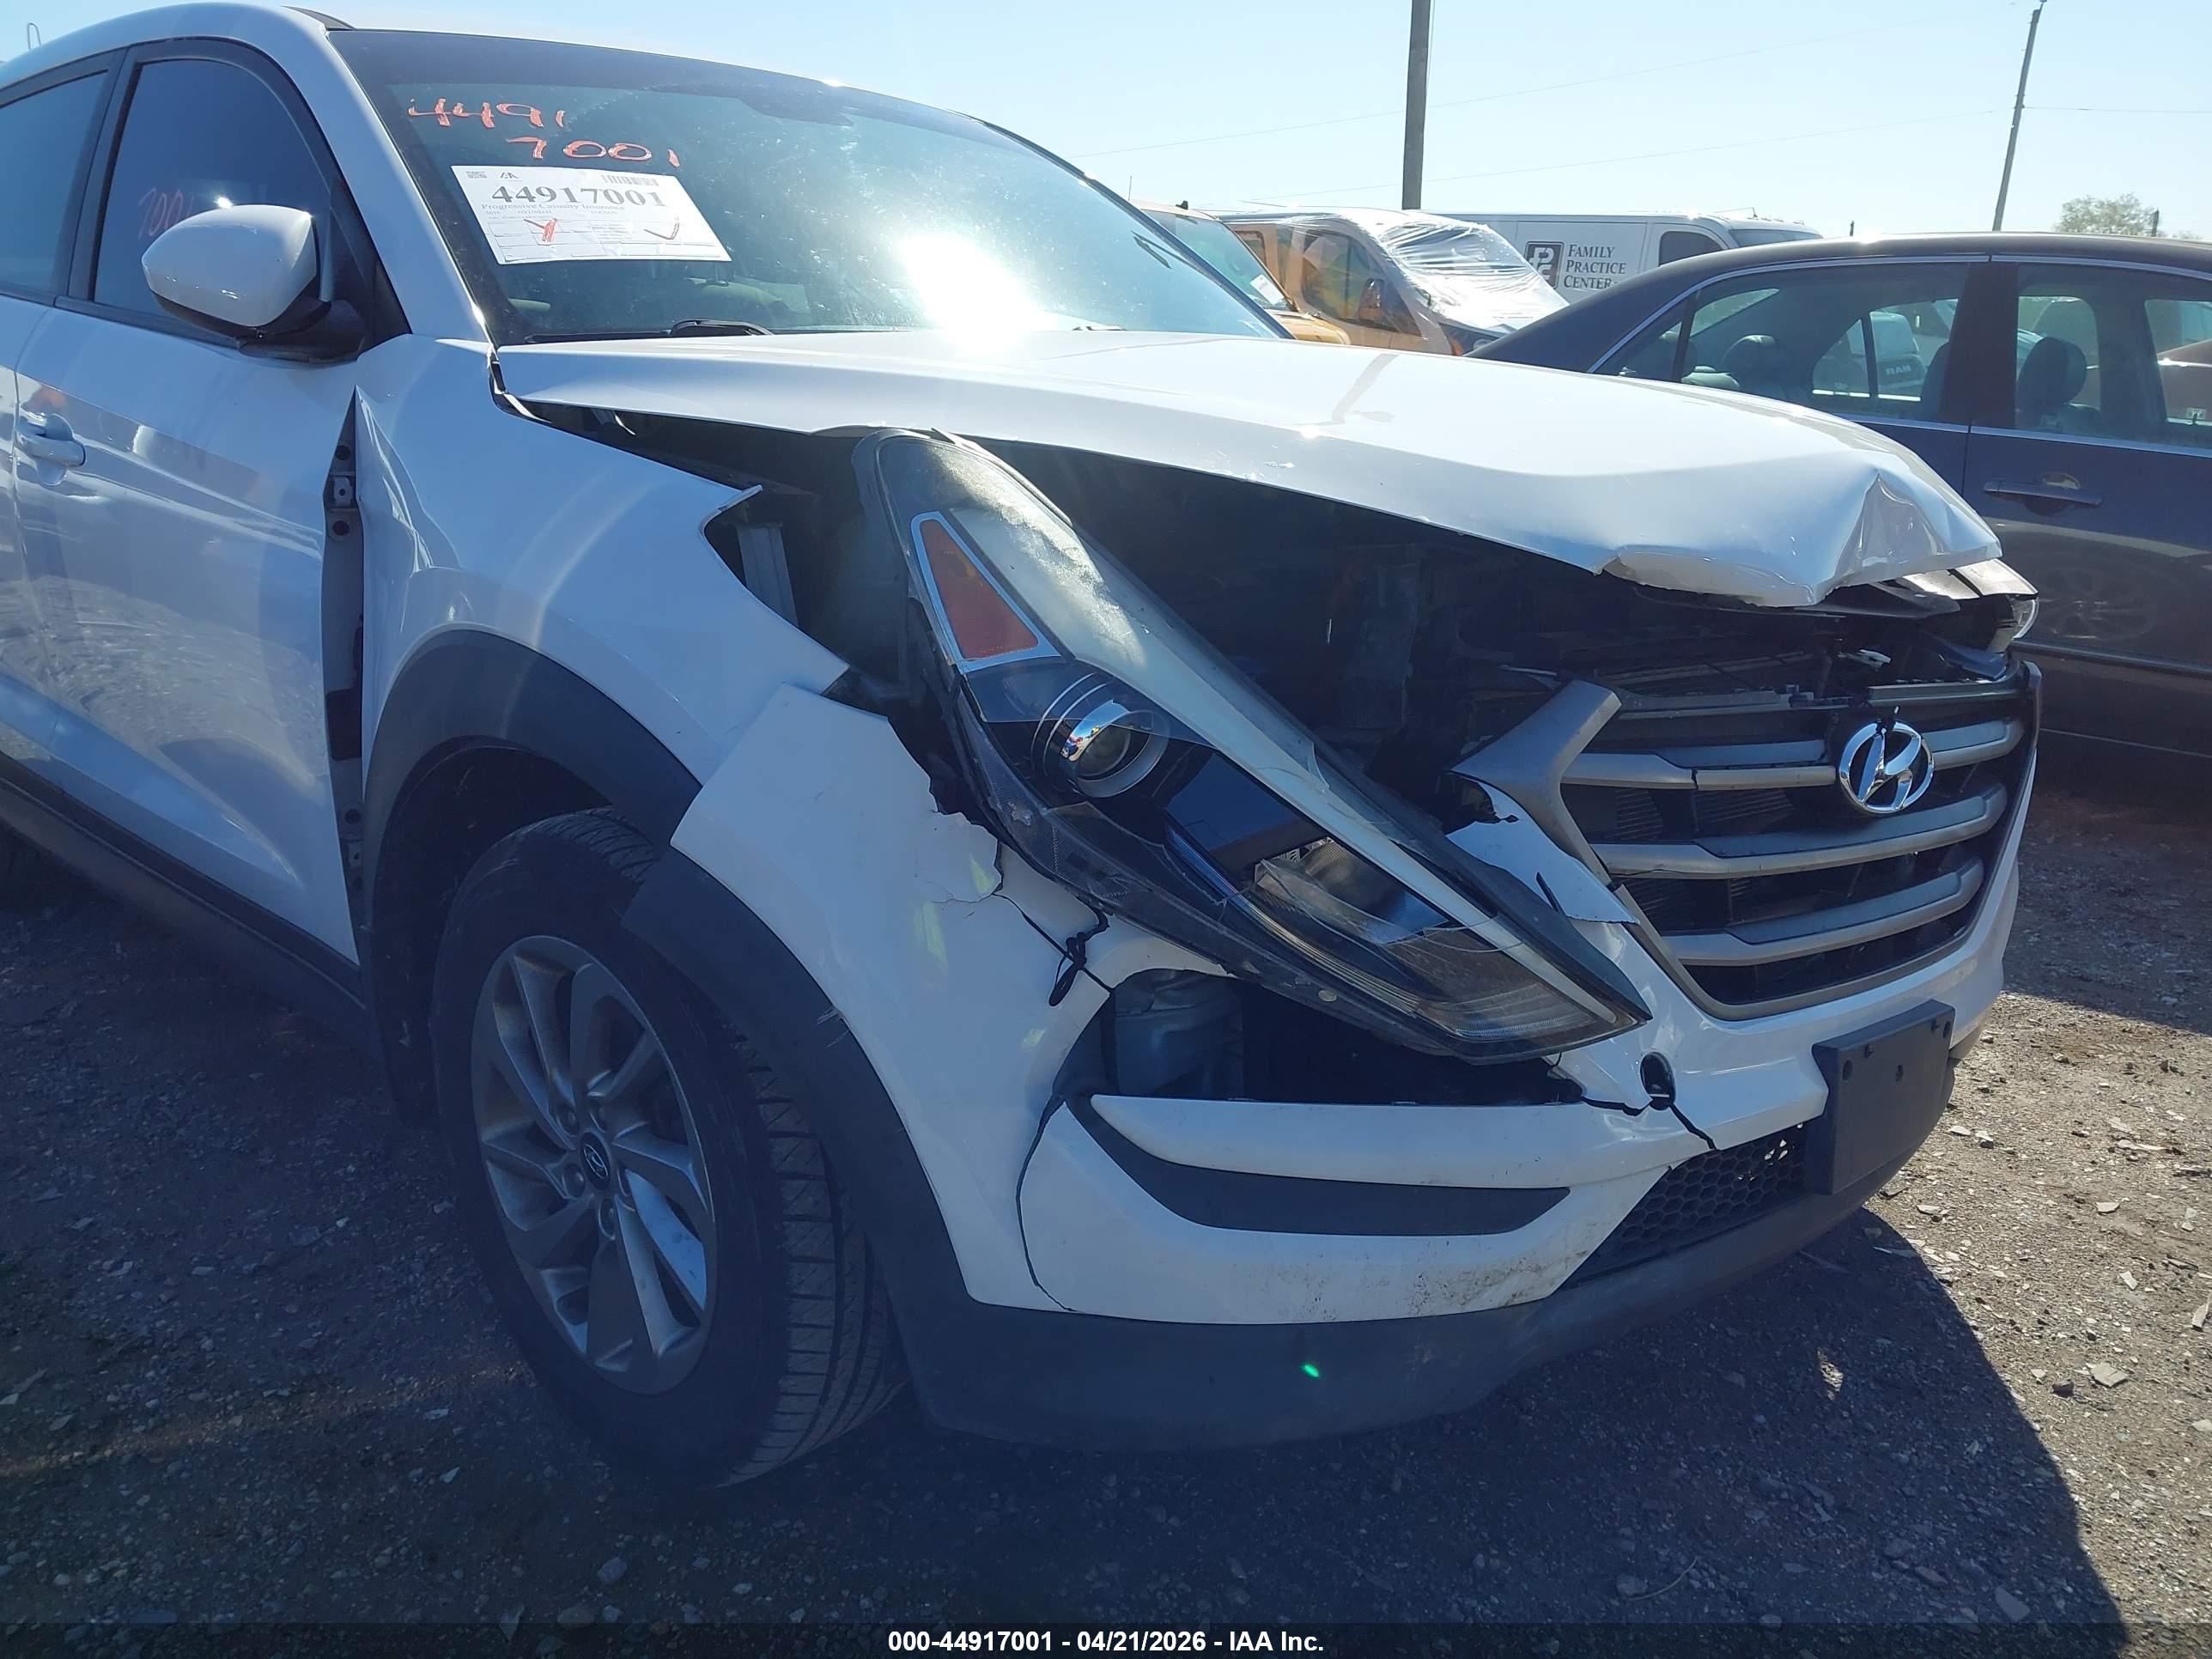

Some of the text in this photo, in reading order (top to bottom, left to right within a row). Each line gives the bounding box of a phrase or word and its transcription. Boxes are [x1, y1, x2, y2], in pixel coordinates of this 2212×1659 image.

[408, 97, 566, 128] 4491
[505, 136, 681, 167] 7001
[491, 185, 667, 206] 44917001
[1568, 244, 1615, 258] FAMILY
[1565, 259, 1626, 275] PRACTICE
[1885, 365, 1911, 375] RAM
